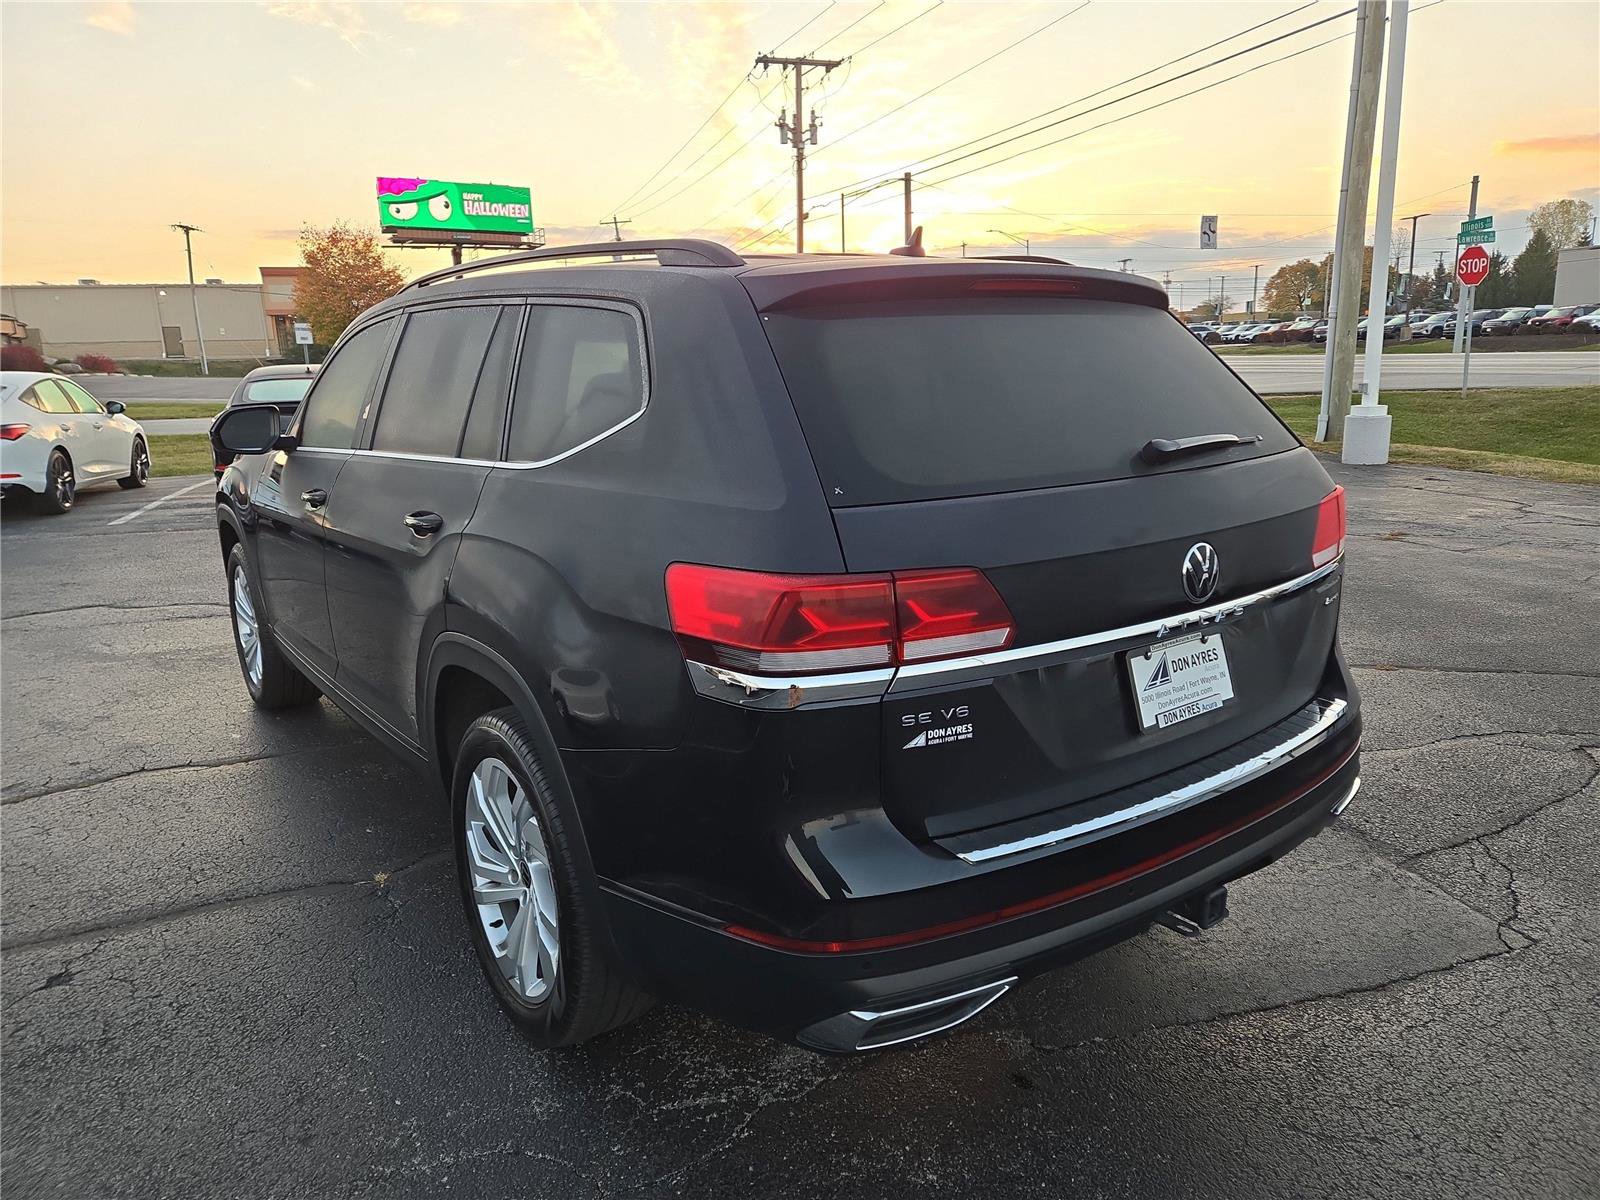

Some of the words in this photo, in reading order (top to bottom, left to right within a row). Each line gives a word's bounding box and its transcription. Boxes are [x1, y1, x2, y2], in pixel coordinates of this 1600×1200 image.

[464, 200, 529, 217] HALLOWEEN
[1461, 221, 1484, 231] Illinois
[1458, 235, 1488, 244] Lawrence
[1460, 258, 1487, 274] STOP
[1156, 605, 1245, 638] ATLAS
[1171, 657, 1191, 673] DON
[1191, 648, 1219, 667] AYRES
[1141, 694, 1154, 705] 5000
[1172, 684, 1186, 694] Road
[1189, 680, 1199, 689] Fort
[1158, 687, 1213, 710] DonAyresAcura.com
[901, 711, 932, 727] SE
[941, 705, 969, 719] V6
[1163, 711, 1178, 725] DON
[1178, 703, 1201, 720] AYRES
[1201, 701, 1218, 712] Acura
[927, 728, 945, 739] DON
[946, 723, 973, 736] AYRES
